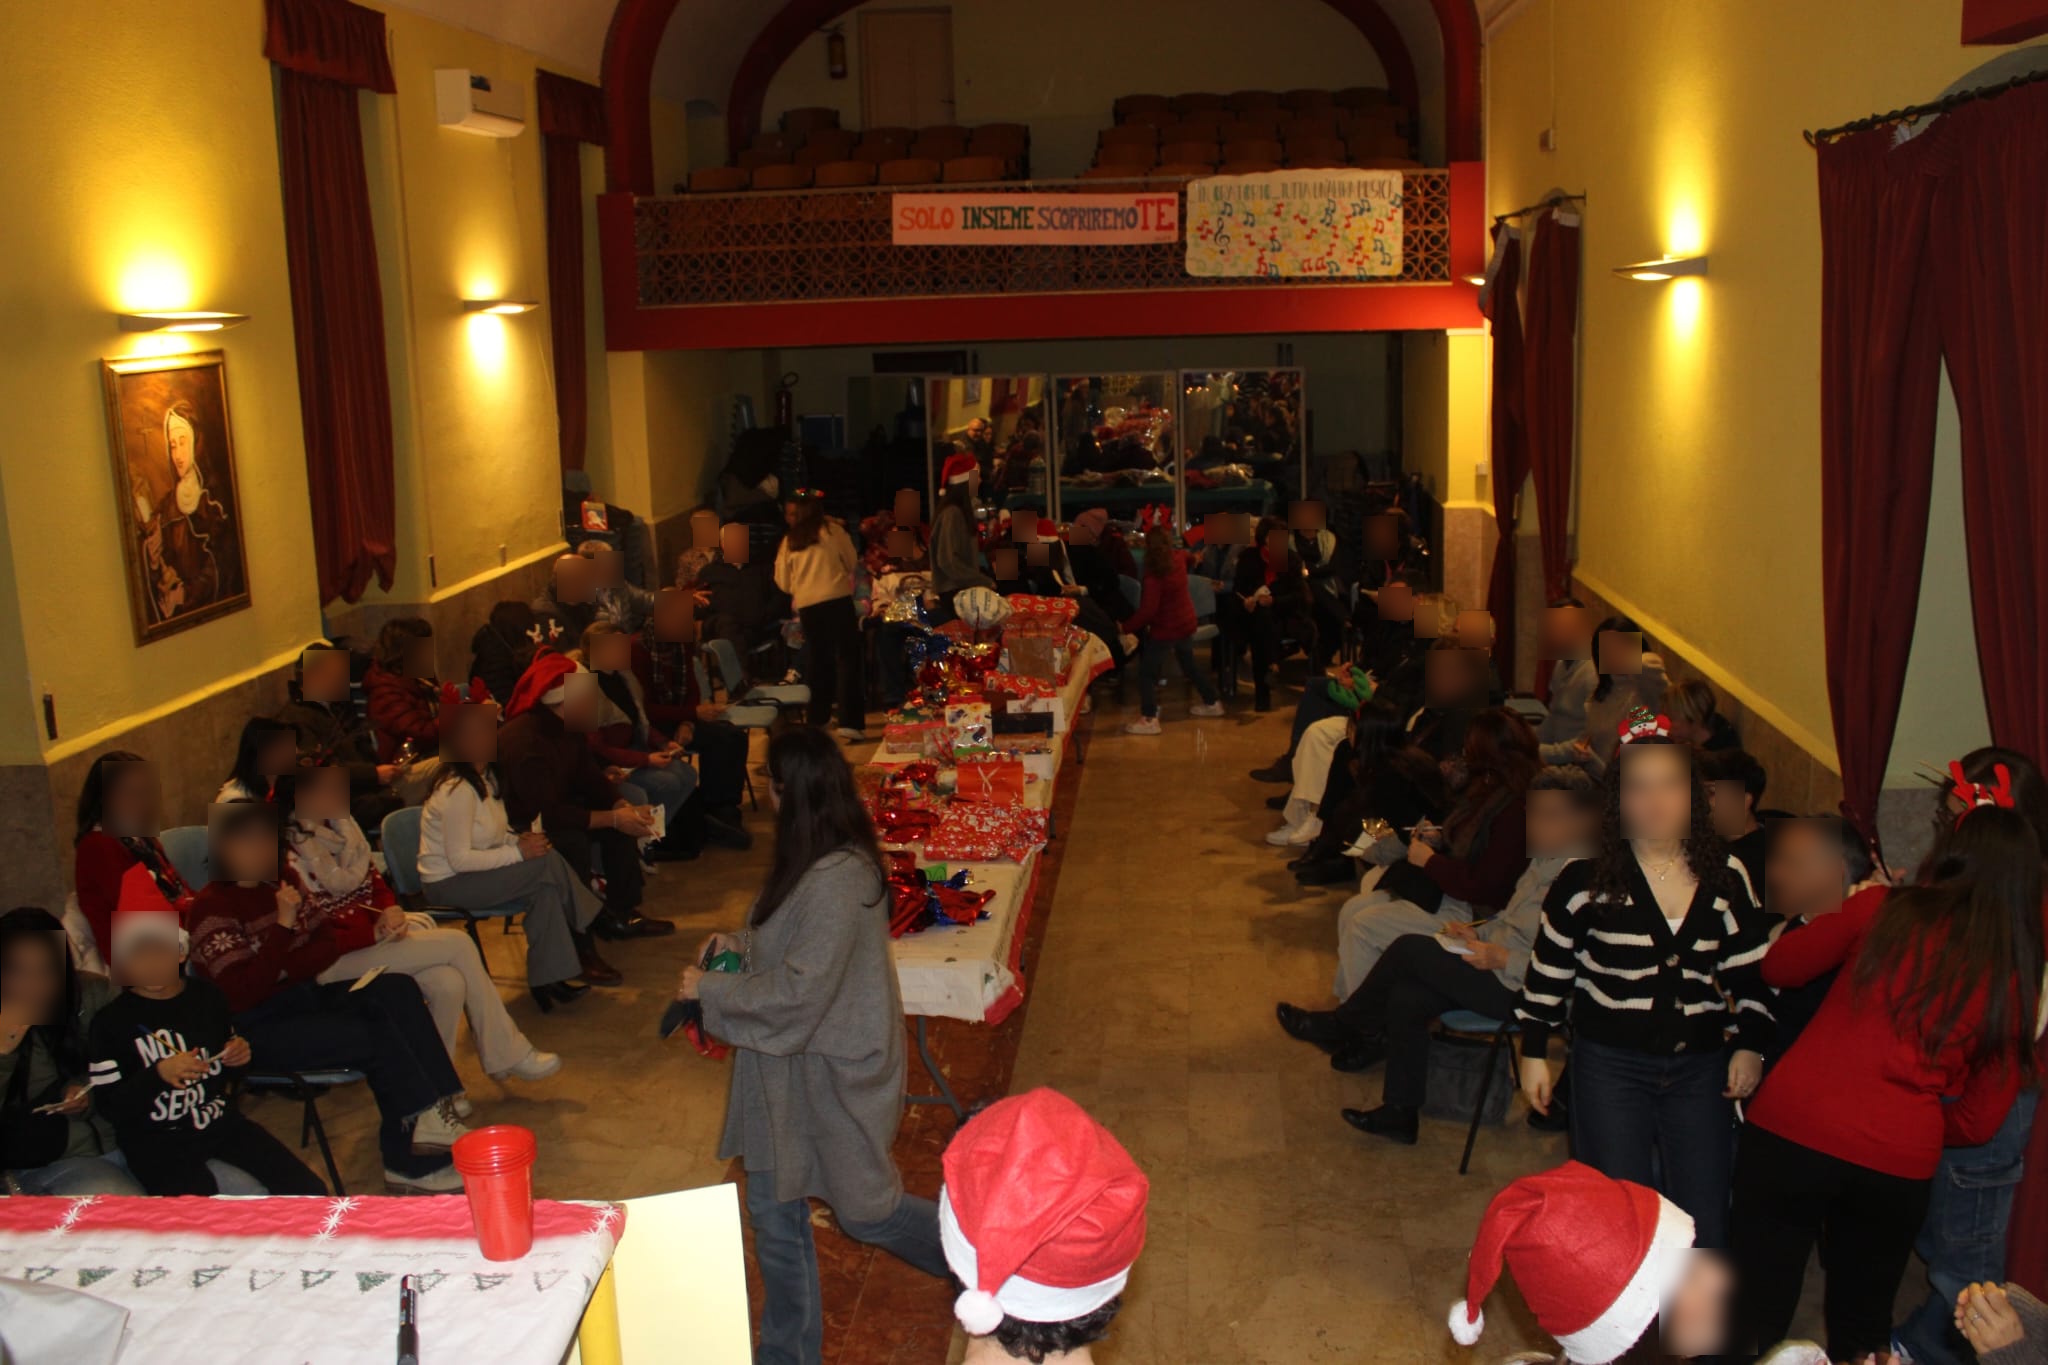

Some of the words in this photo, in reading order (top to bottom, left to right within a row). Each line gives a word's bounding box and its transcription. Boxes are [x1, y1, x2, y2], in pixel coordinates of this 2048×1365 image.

[898, 206, 955, 231] SOLO
[961, 206, 1035, 230] INSIEME
[1136, 197, 1176, 231] TE
